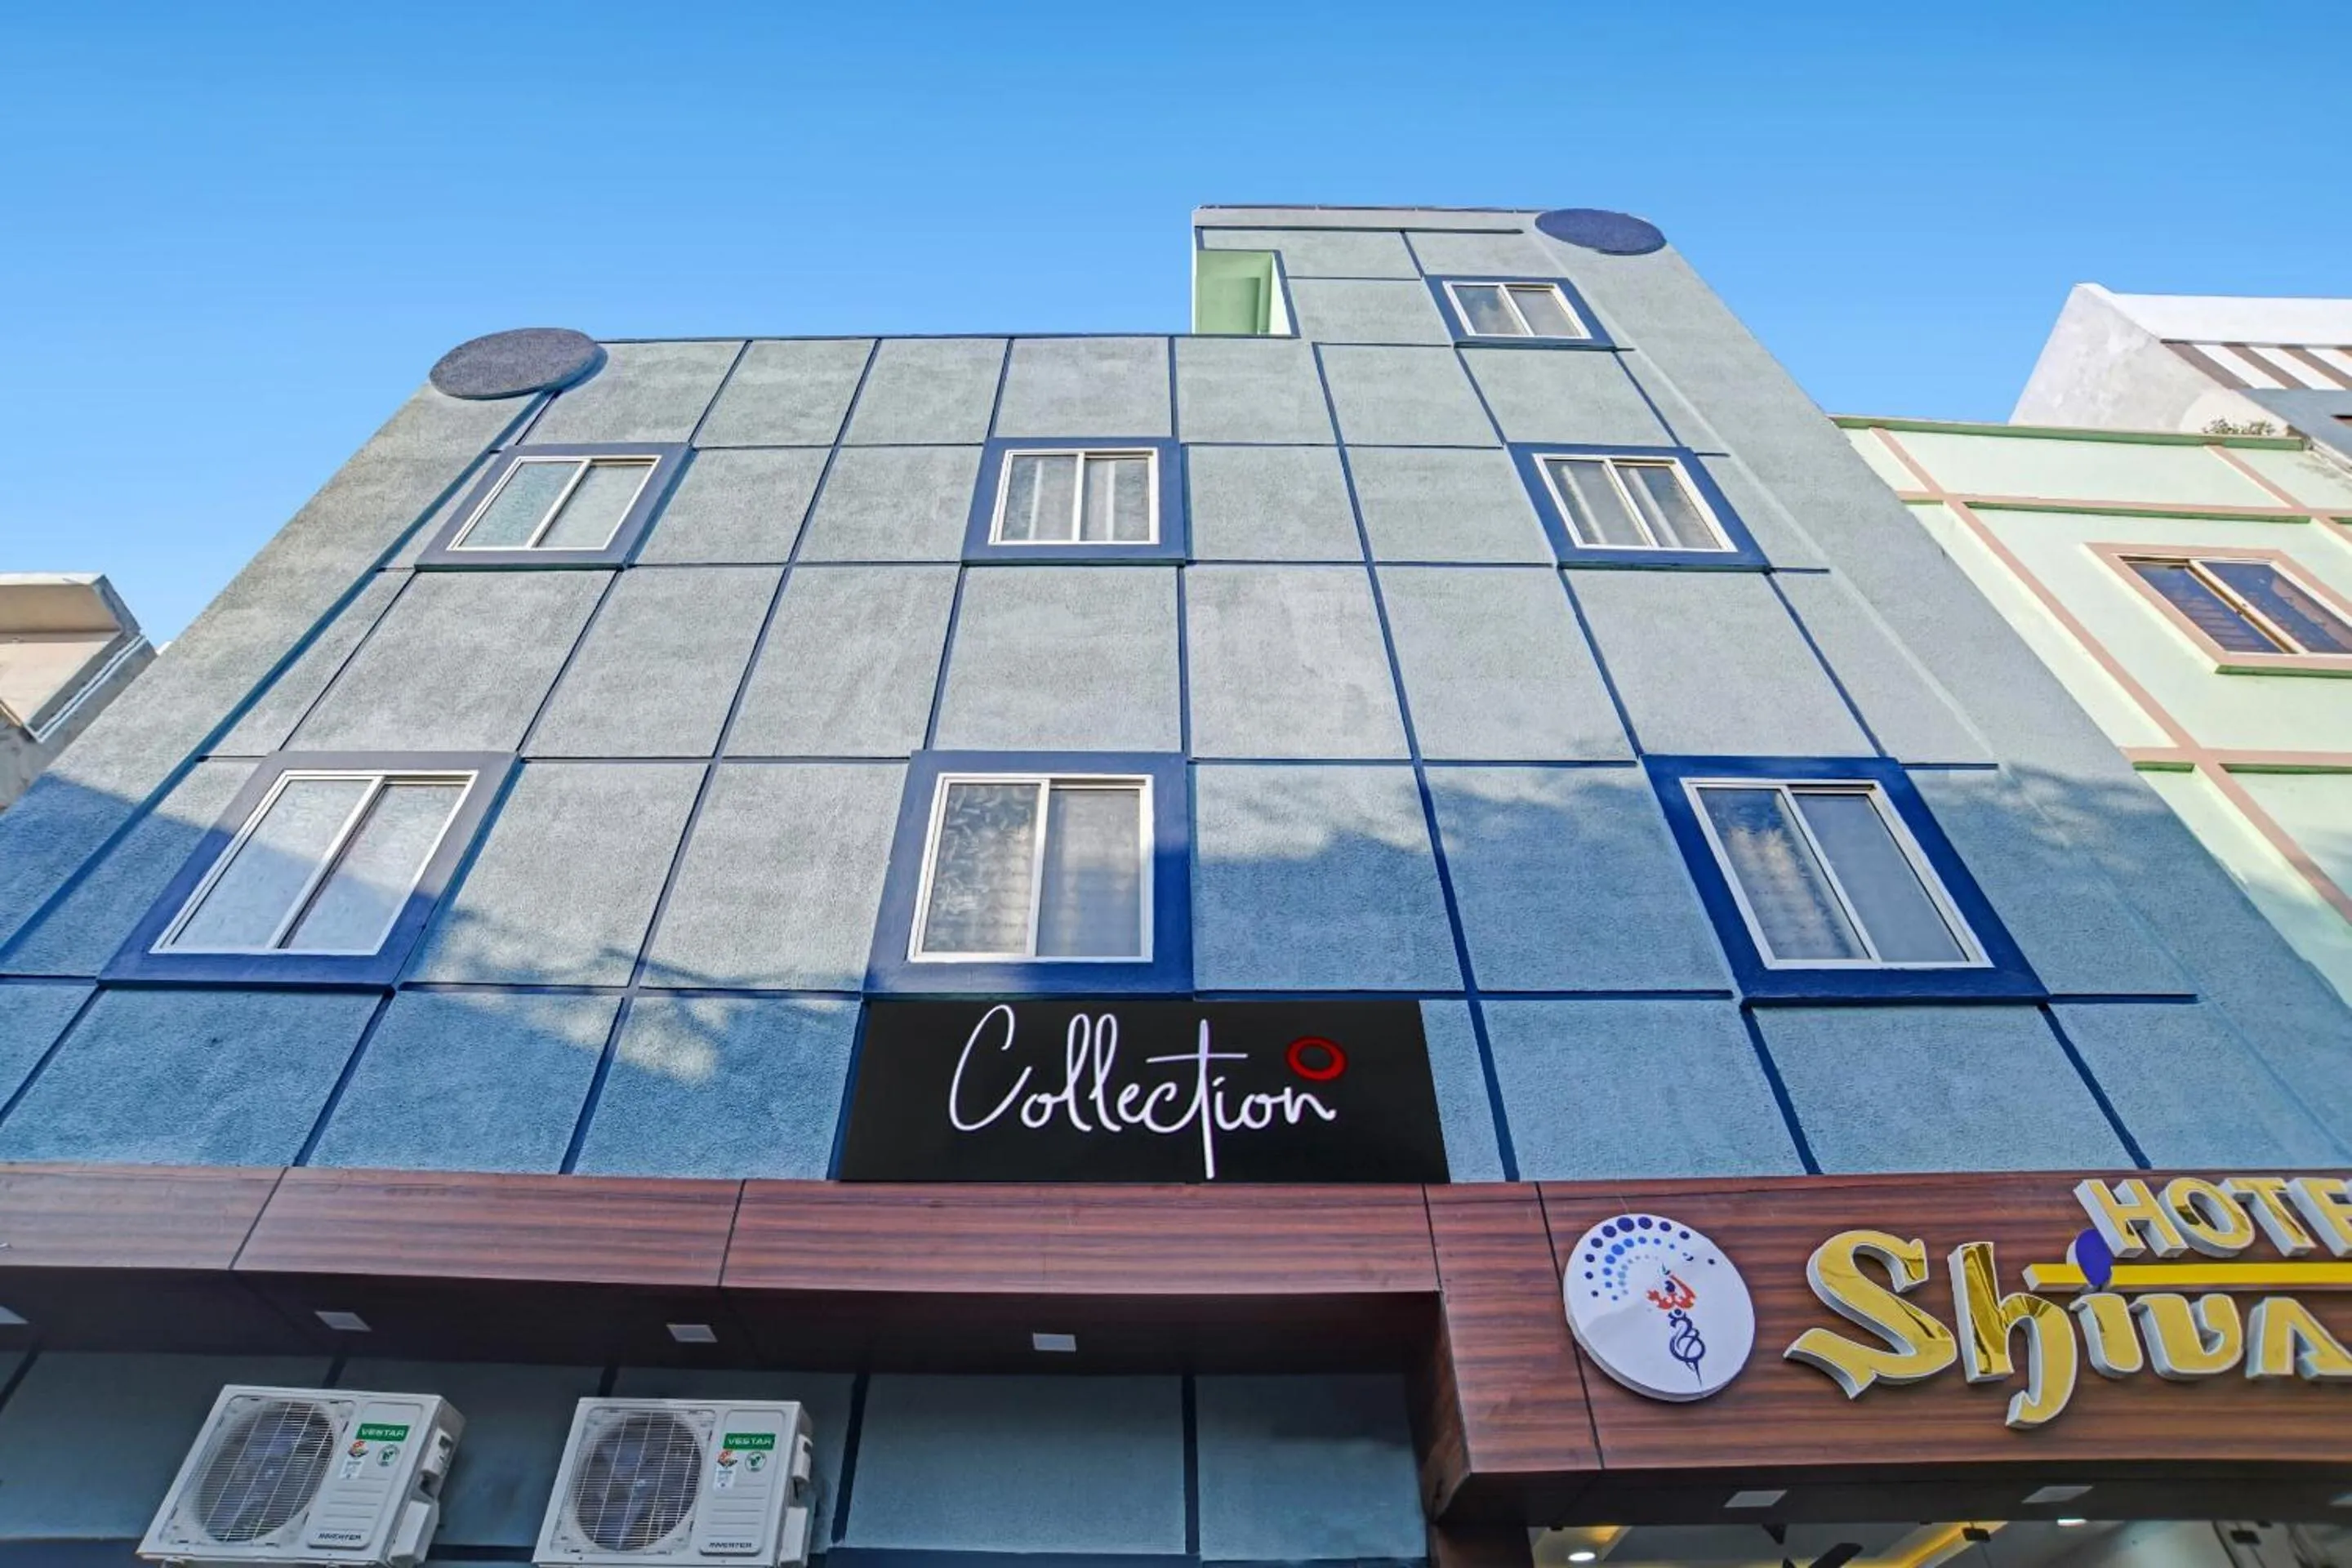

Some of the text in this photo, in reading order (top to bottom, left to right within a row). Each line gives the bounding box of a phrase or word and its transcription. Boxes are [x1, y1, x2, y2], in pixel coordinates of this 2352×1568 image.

[948, 1004, 1337, 1179] Collection
[2074, 1176, 2352, 1258] HOTE
[361, 1428, 406, 1437] VESTAR
[728, 1437, 772, 1446] VESTAR
